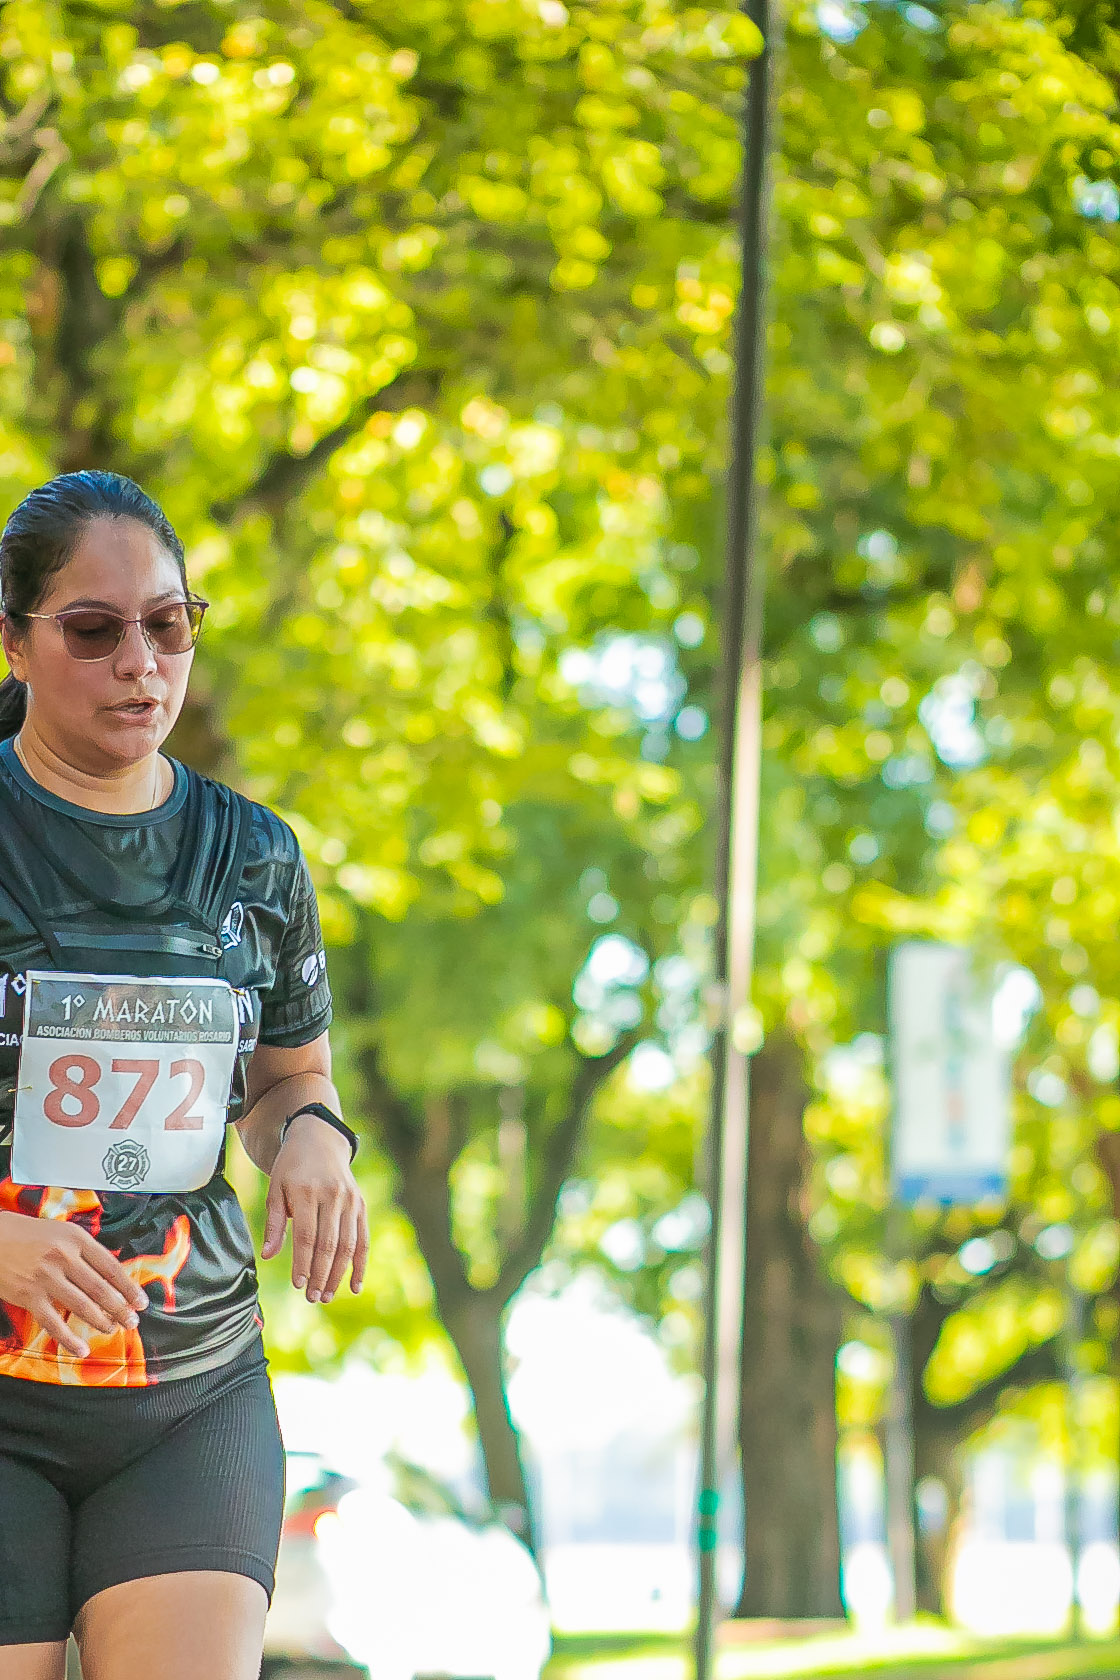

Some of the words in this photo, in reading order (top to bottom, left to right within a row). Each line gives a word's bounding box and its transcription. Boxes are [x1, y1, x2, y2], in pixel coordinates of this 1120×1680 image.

[92, 991, 213, 1025] MARATÓN
[43, 1054, 206, 1131] 872
[117, 1154, 137, 1172] 27
